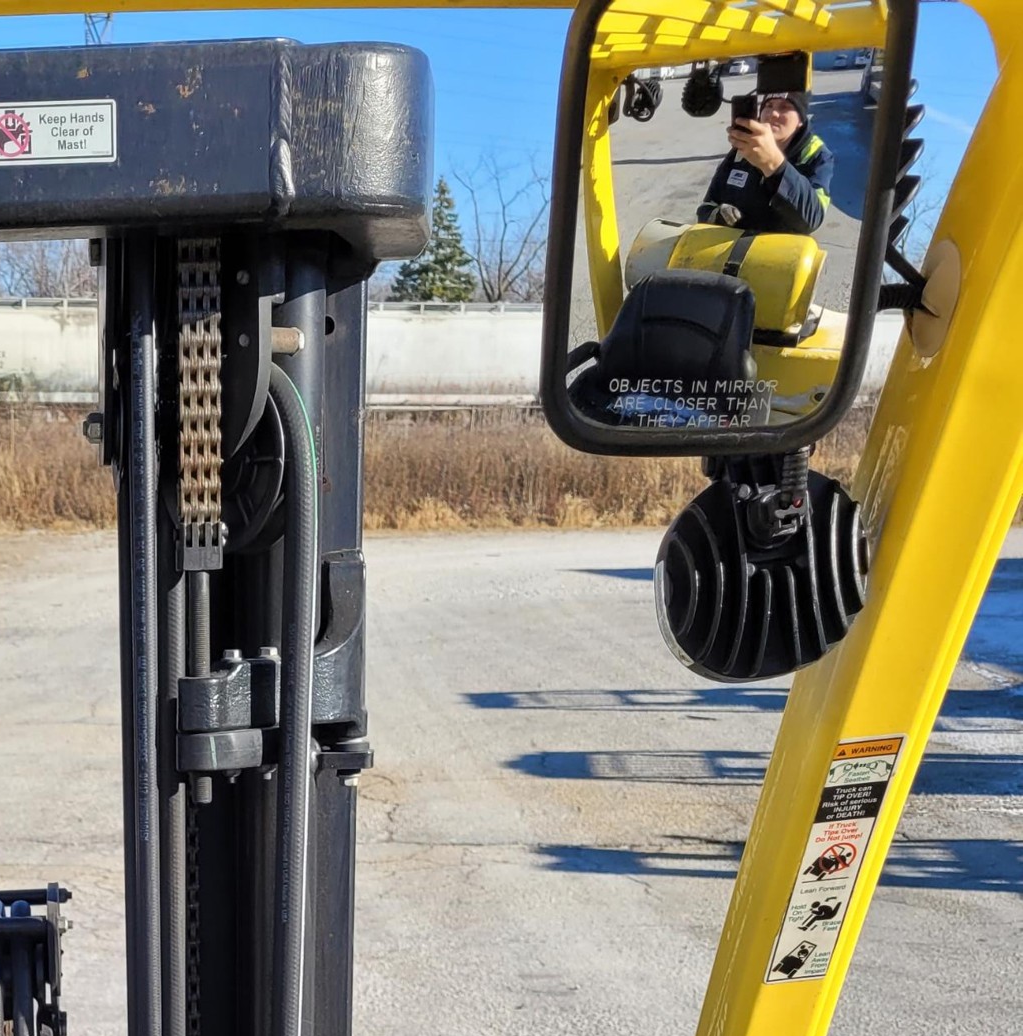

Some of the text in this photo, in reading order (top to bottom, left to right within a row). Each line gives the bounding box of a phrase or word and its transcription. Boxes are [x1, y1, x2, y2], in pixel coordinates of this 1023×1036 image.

[39, 112, 105, 125] Keep Hands
[51, 125, 94, 137] Clear of
[57, 139, 87, 150] Mast!
[608, 378, 778, 393] OBJECTS IN MIRROR
[613, 397, 771, 411] ARE CLOSER THAN
[637, 414, 751, 428] THEY APPEAR
[851, 744, 893, 754] WARNING
[846, 791, 872, 799] OVER!
[849, 797, 878, 805] serious
[833, 804, 863, 813] INJURY
[836, 810, 866, 819] DEATH!
[818, 884, 847, 892] Forward
